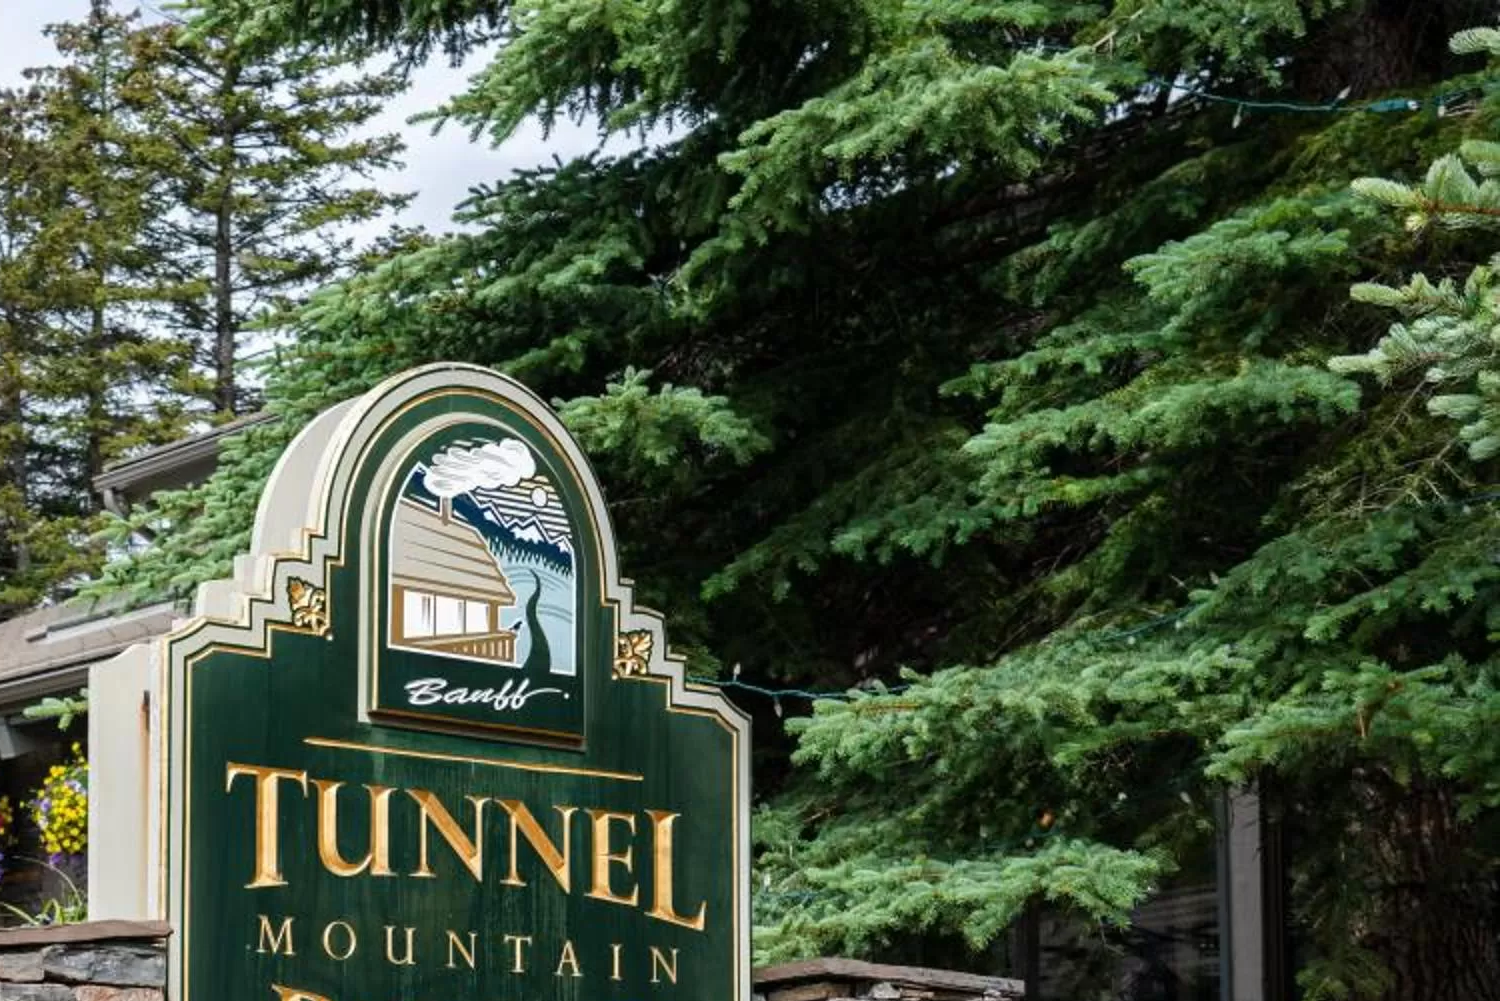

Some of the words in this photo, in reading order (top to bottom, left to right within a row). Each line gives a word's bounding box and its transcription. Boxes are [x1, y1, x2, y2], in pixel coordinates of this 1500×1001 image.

[403, 677, 563, 710] Banff
[226, 762, 706, 931] TUNNEL
[256, 914, 680, 984] MOUNTAIN
